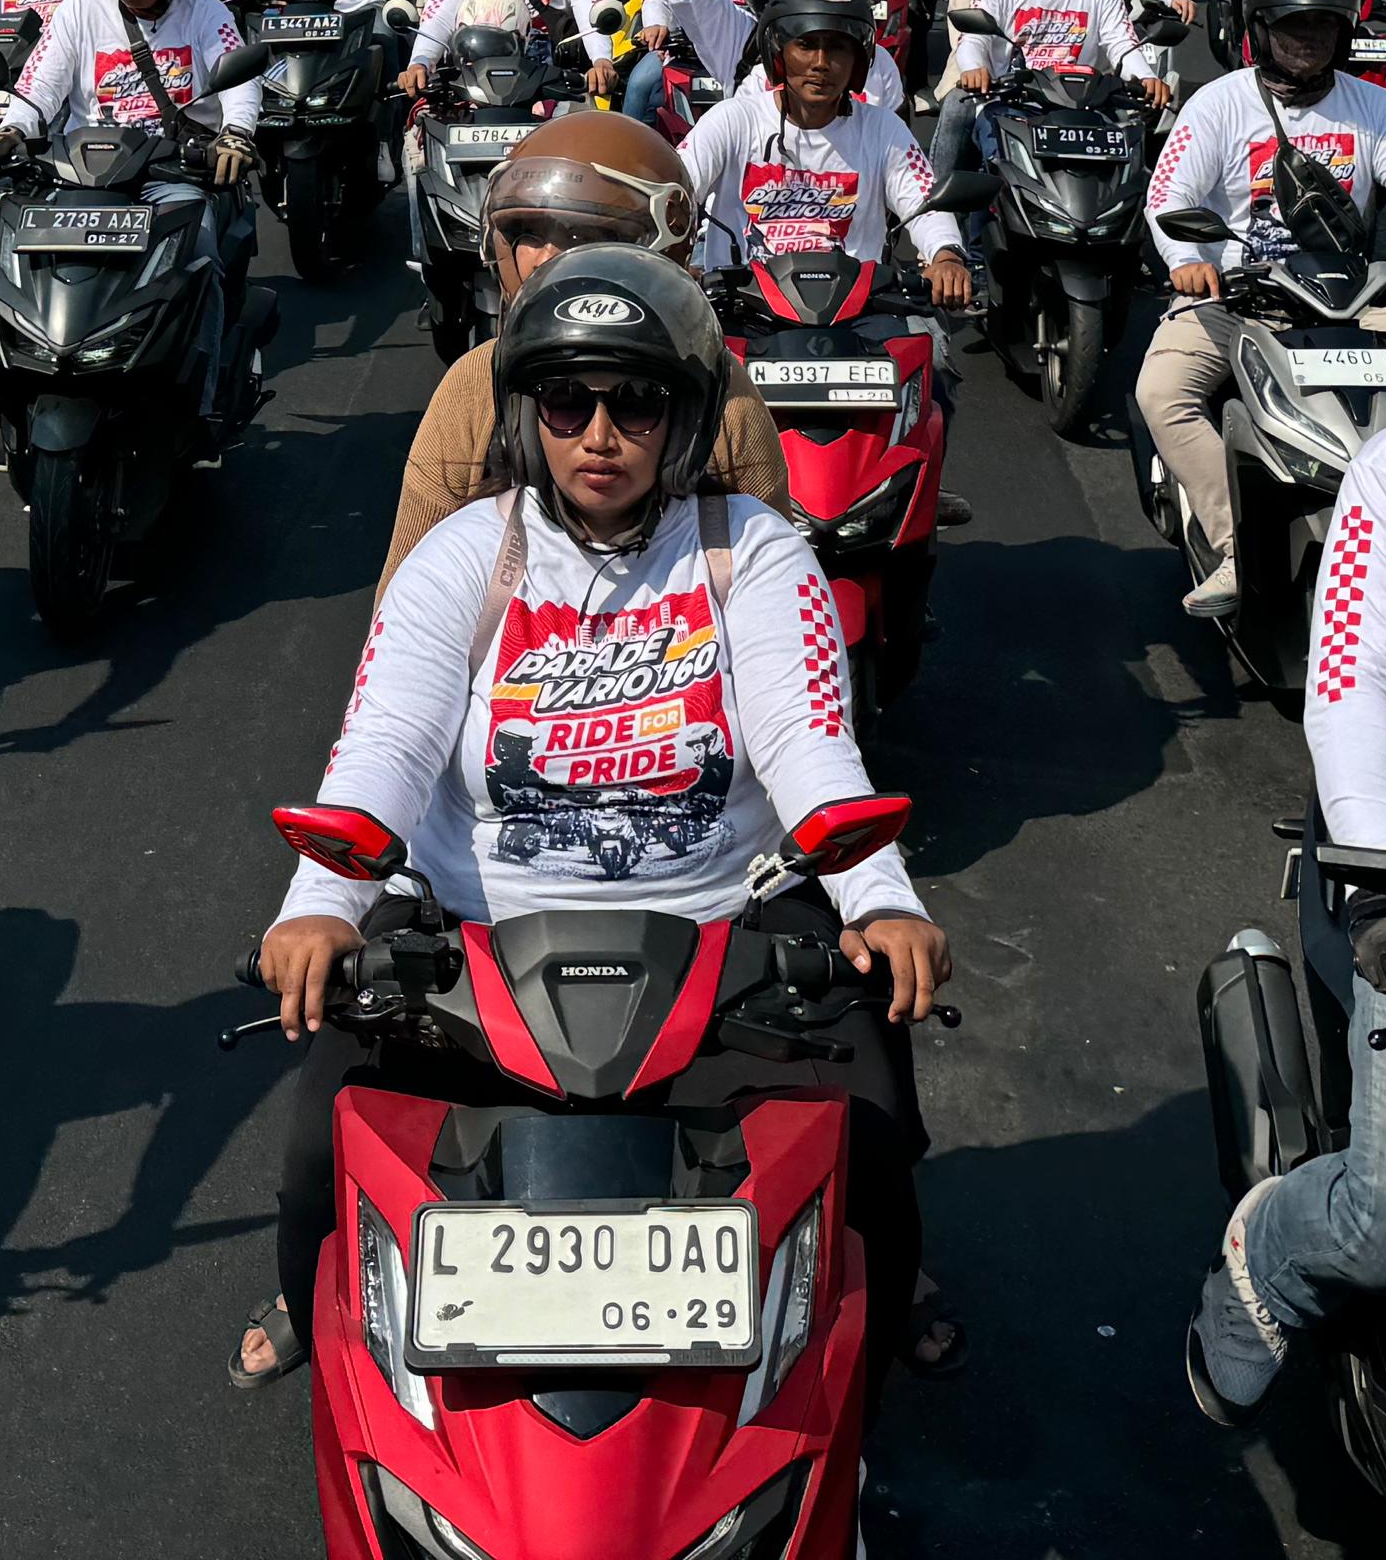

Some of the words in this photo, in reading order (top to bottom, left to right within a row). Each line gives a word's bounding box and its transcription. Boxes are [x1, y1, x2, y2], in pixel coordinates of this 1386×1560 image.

[268, 20, 276, 29] L
[280, 18, 311, 29] 5447
[313, 16, 339, 28] AAZ
[457, 129, 466, 142] L
[471, 128, 509, 142] 6784
[1036, 129, 1048, 140] W
[1059, 130, 1094, 142] 2014
[1106, 131, 1124, 144] EP
[747, 189, 833, 206] PARADE
[25, 212, 36, 228] L
[52, 212, 101, 228] 2735
[107, 212, 144, 228] AAZ
[762, 205, 821, 220] VARIO
[823, 206, 853, 220] 160
[766, 223, 808, 238] RIDE
[775, 239, 824, 253] PRIDE
[1291, 351, 1304, 366] L
[1323, 350, 1372, 366] 4460
[754, 366, 766, 378] N
[779, 366, 830, 383] 3937
[506, 628, 674, 681] PARADE
[535, 665, 657, 712] VARIO
[655, 642, 717, 691] 160
[544, 715, 637, 752] RIDE
[641, 711, 680, 732] FOR
[567, 743, 678, 786] PRIDE
[561, 965, 629, 977] HONDA
[432, 1224, 460, 1276] L
[489, 1223, 616, 1274] 2930
